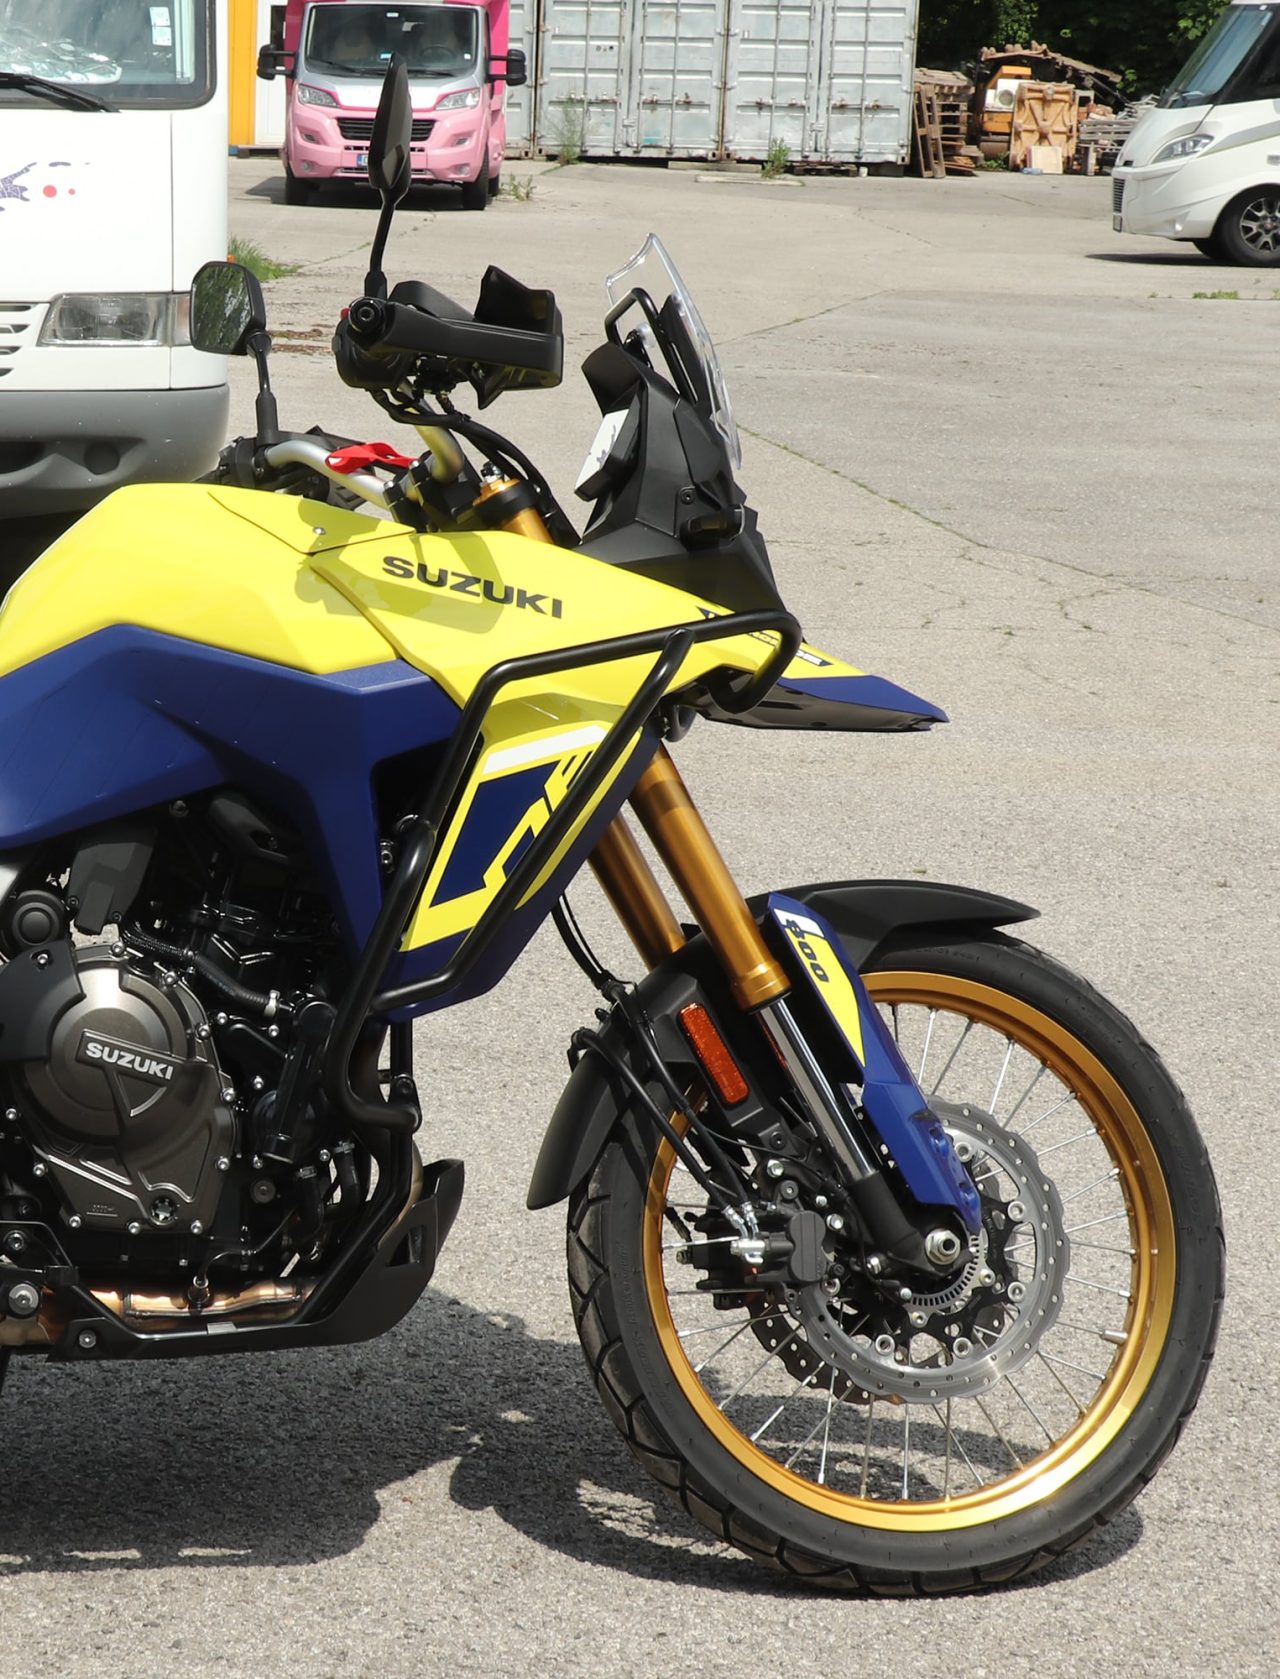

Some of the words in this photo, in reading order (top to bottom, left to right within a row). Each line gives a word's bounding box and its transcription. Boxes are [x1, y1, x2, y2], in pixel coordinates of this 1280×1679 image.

[382, 555, 563, 620] SUZUKI
[785, 918, 830, 983] 800
[85, 1041, 174, 1080] SUZUKI
